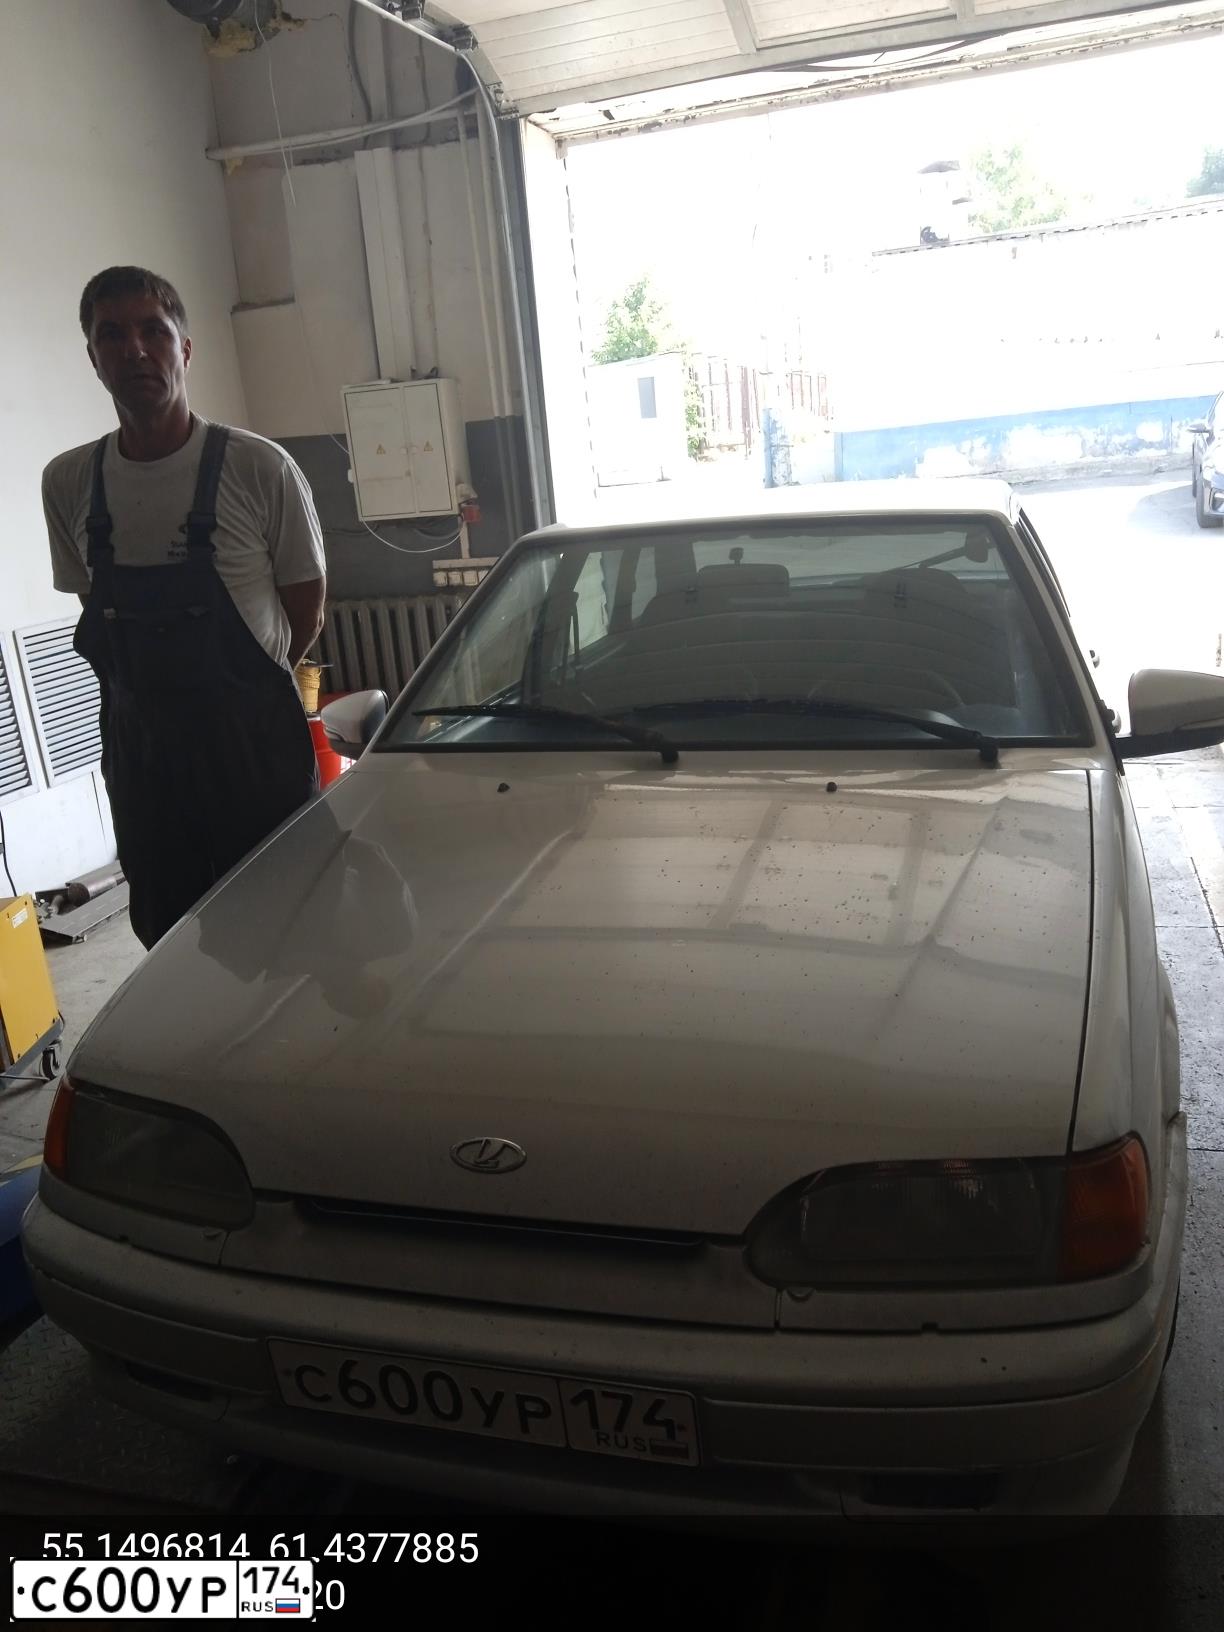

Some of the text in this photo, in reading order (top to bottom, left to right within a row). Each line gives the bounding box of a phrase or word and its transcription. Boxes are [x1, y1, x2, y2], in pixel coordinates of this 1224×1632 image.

[294, 1358, 679, 1441] С600УР 174
[595, 1430, 648, 1453] RUS
